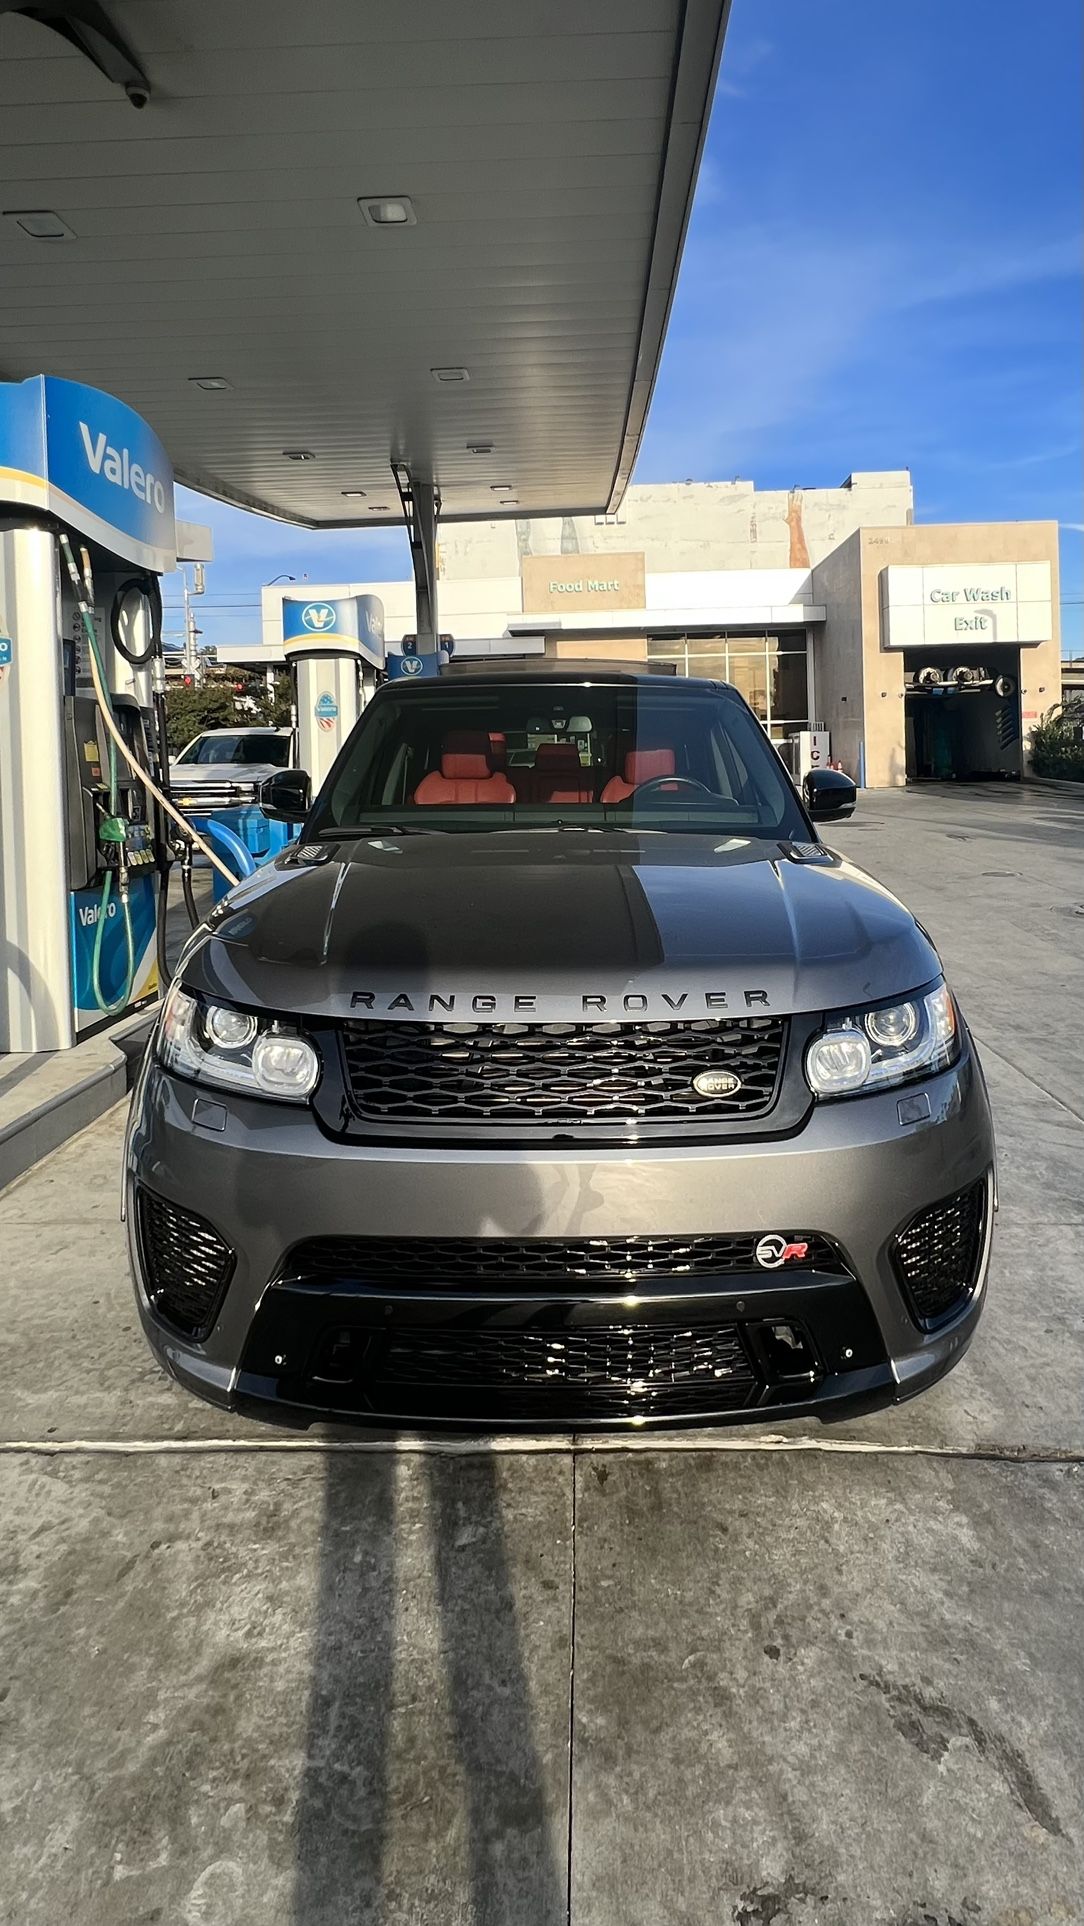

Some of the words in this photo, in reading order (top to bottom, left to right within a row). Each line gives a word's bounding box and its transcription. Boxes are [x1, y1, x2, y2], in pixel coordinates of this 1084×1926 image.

[79, 421, 165, 513] Valero
[549, 580, 583, 593] Food
[587, 579, 620, 592] Mart
[930, 589, 959, 603] Car
[964, 586, 1011, 602] Wash
[954, 616, 988, 631] Exit
[79, 902, 116, 926] Valo
[350, 991, 537, 1013] RANGE
[582, 989, 771, 1012] ROVER
[756, 1234, 808, 1268] SVR
